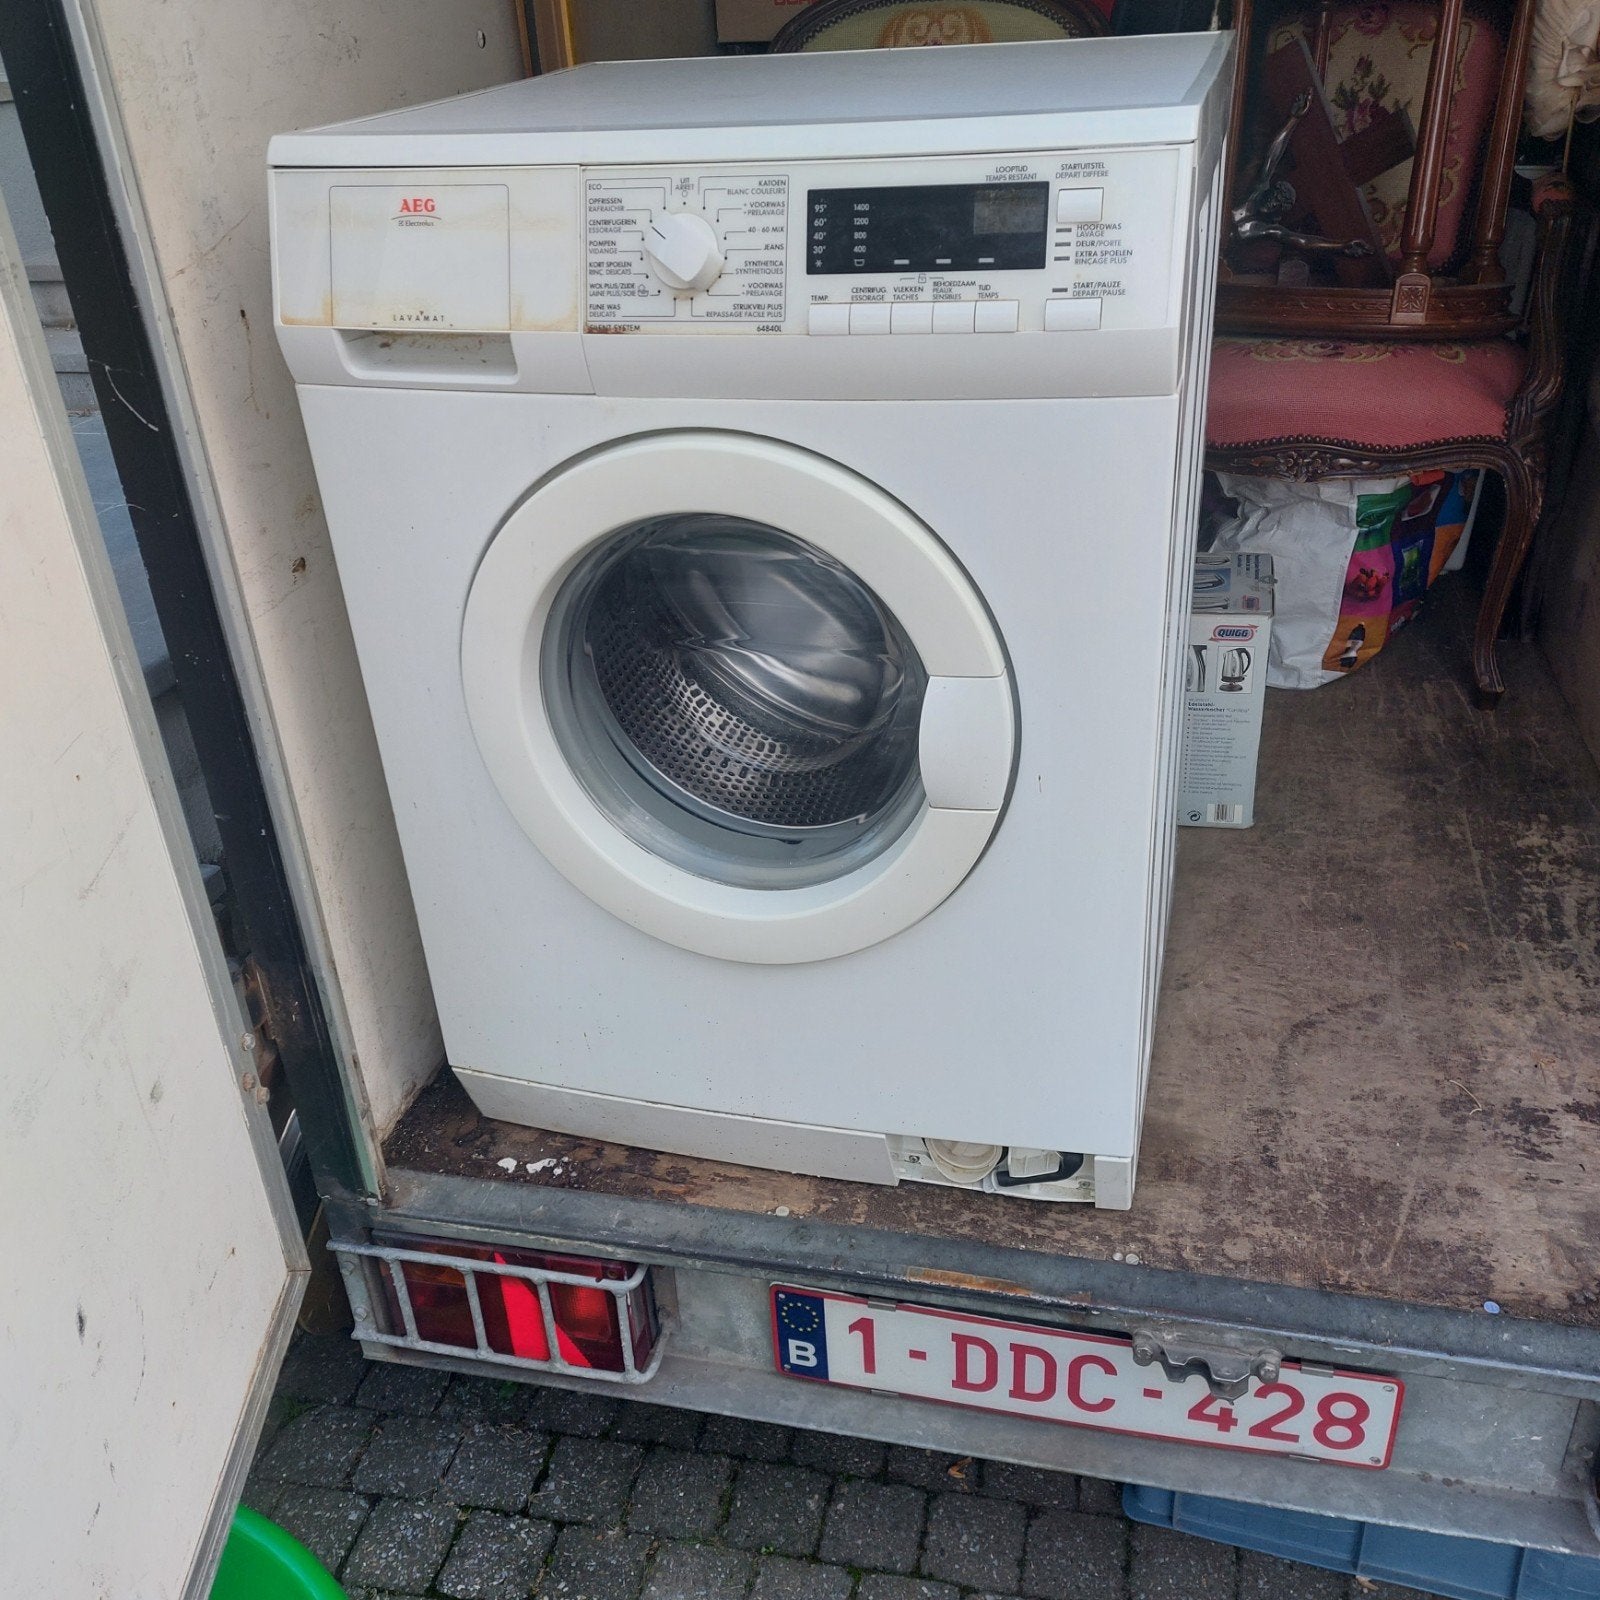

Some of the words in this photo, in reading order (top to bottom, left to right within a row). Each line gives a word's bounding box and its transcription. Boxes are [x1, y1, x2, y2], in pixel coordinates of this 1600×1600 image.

[1061, 162, 1105, 170] STARTUITSTEL
[985, 174, 1007, 182] TEMPS
[1008, 173, 1037, 181] RESTANT
[1055, 171, 1081, 179] DEPART
[750, 187, 786, 195] COULEURS
[399, 198, 436, 213] AEG
[853, 203, 870, 211] 1400
[405, 219, 434, 227] Electrolux
[853, 217, 869, 225] 1200
[1076, 222, 1122, 231] HOOFDWAS
[853, 231, 867, 239] 800
[1076, 230, 1104, 238] LAVAGE
[763, 243, 784, 251] JEANS
[853, 245, 867, 253] 400
[1100, 249, 1133, 257] SPOELEN
[735, 267, 784, 275] SYNTHETIQUES
[893, 285, 924, 293] VLEKKEN
[1073, 281, 1121, 289] START/PAUZE
[892, 293, 919, 301] TACHES
[1072, 289, 1126, 297] DEPART/PAUSE
[851, 294, 885, 302] ESSORAGE
[613, 324, 641, 332] SYSTEM
[1217, 628, 1249, 638] QUIGG
[788, 1338, 818, 1368] B
